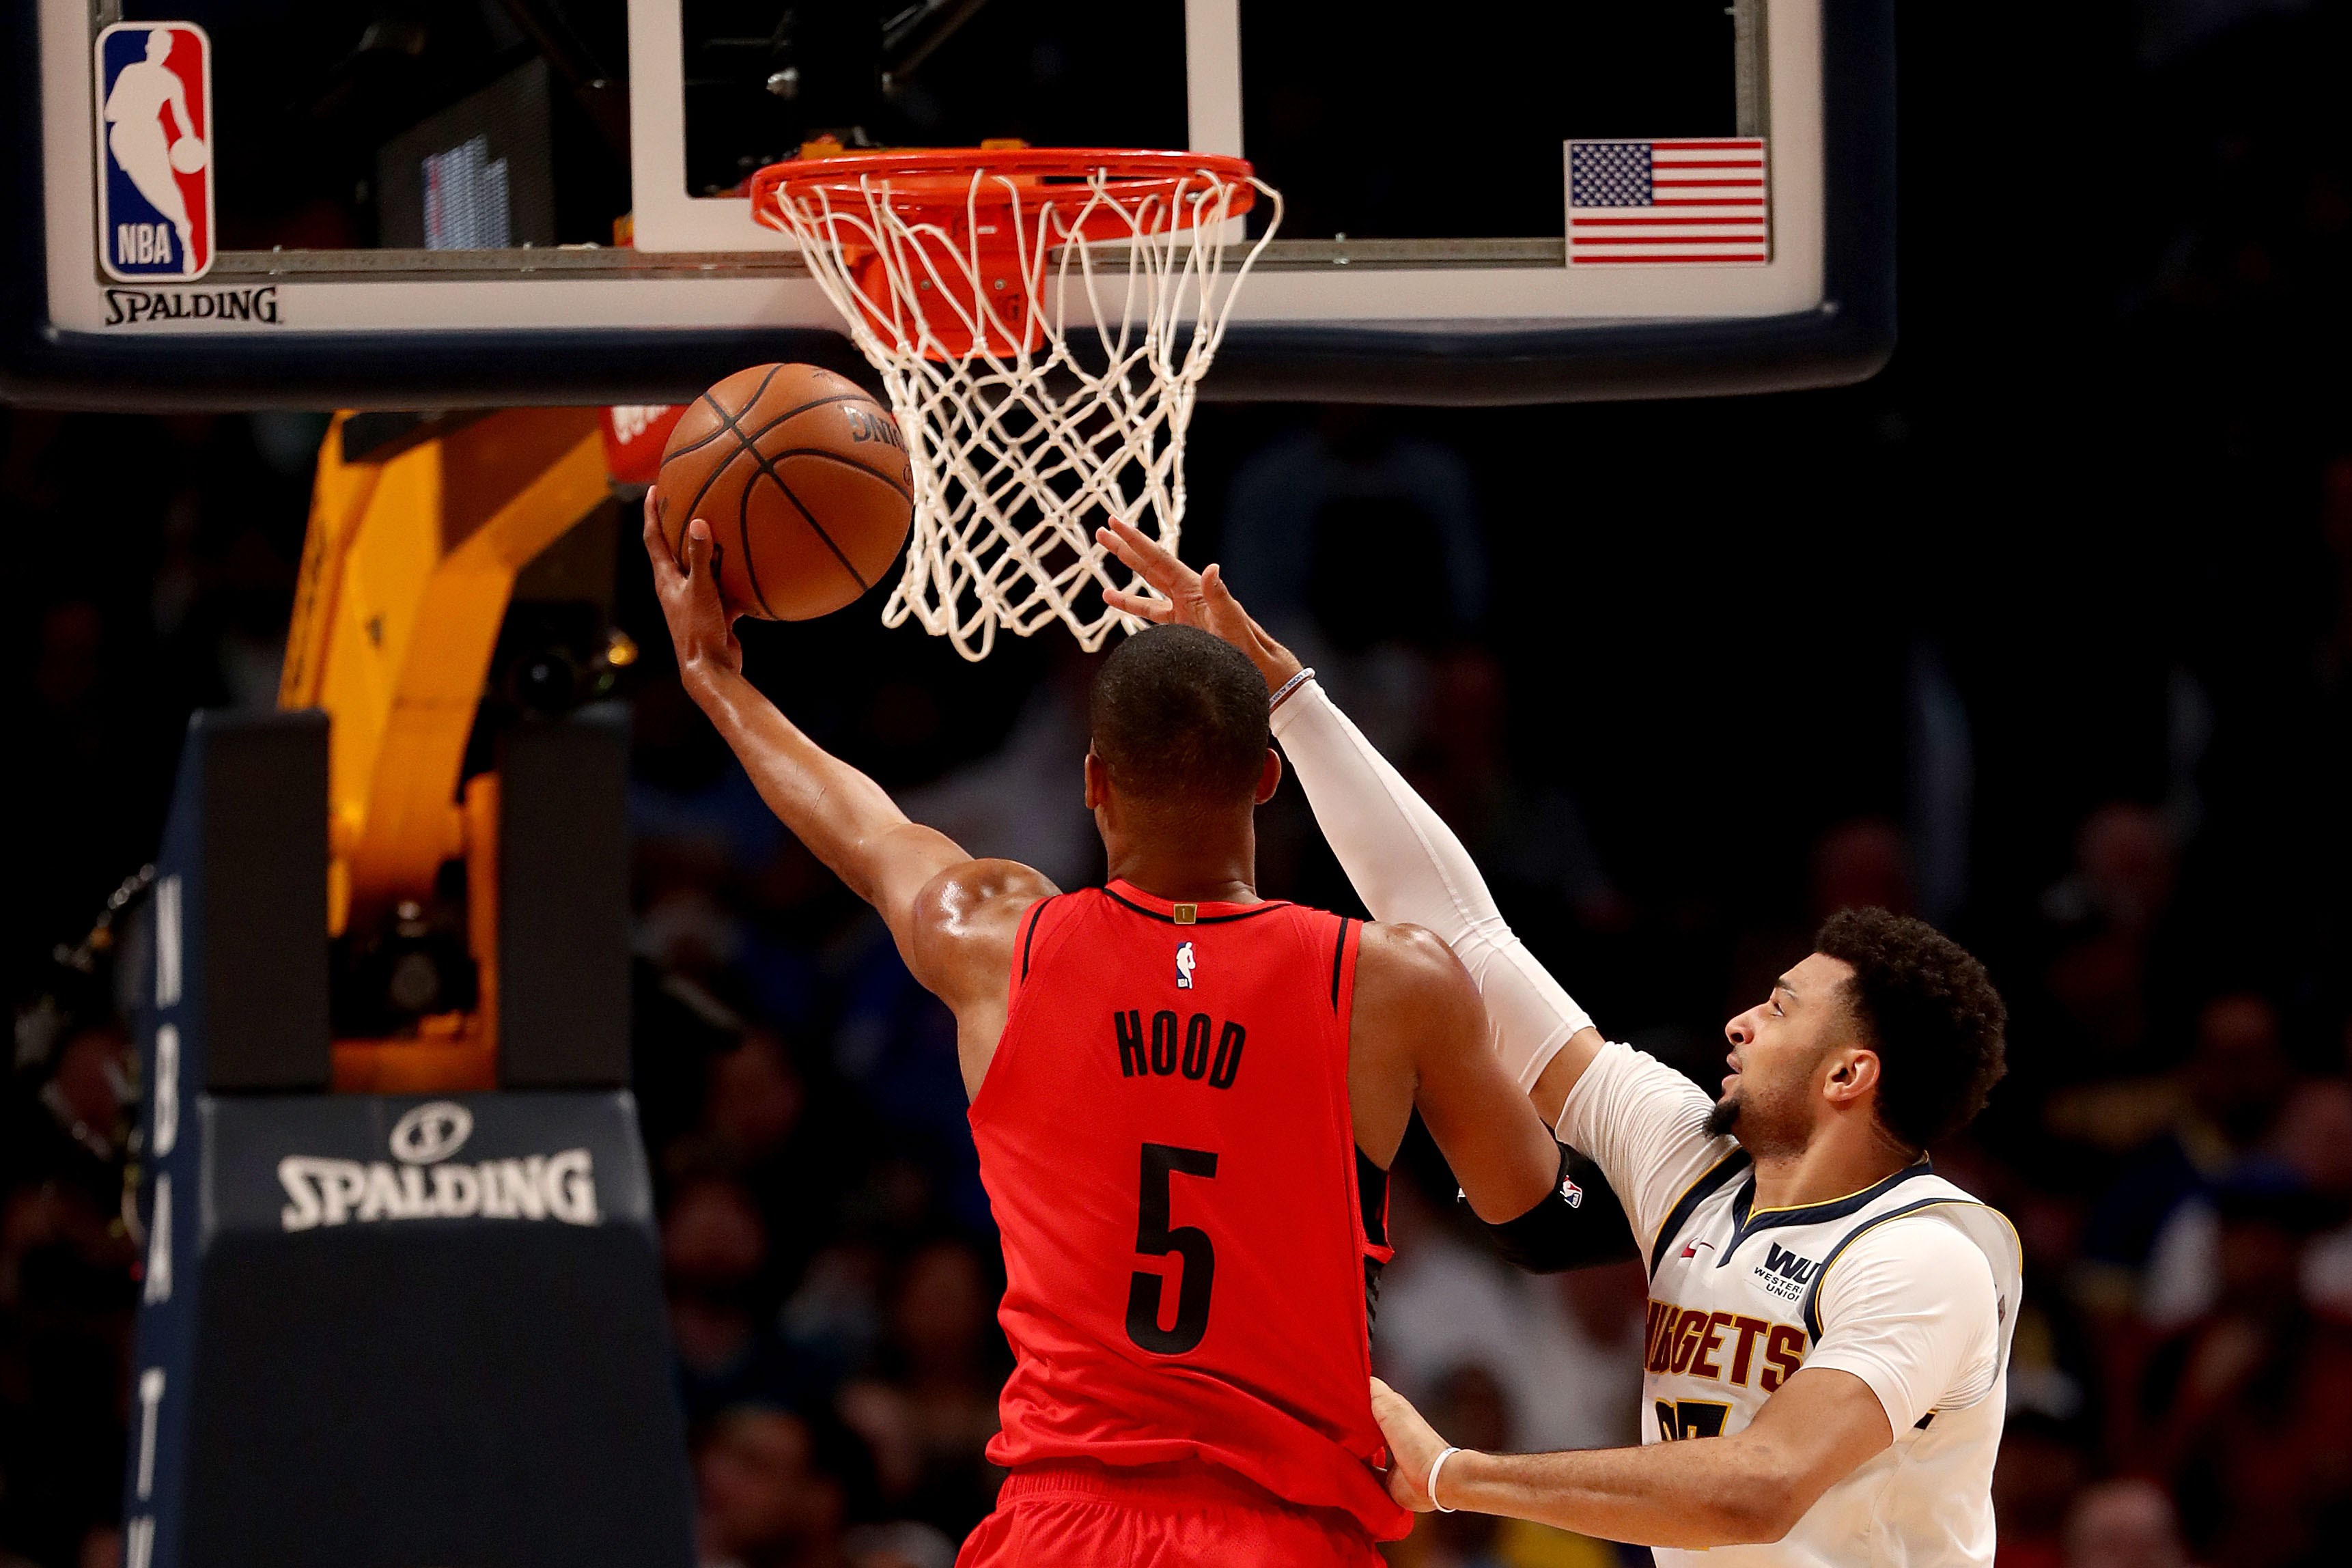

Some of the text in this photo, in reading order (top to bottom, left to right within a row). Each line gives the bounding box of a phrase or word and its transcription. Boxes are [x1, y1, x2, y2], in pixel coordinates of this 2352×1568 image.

[117, 223, 172, 264] NBA
[105, 286, 277, 326] SPALDING
[1114, 1010, 1246, 1089] HOOD
[278, 1148, 599, 1233] SPALDING
[1125, 1143, 1218, 1355] 5
[1765, 1242, 1822, 1285] WU
[1754, 1267, 1804, 1294] WESTER
[1766, 1284, 1800, 1302] UNIO
